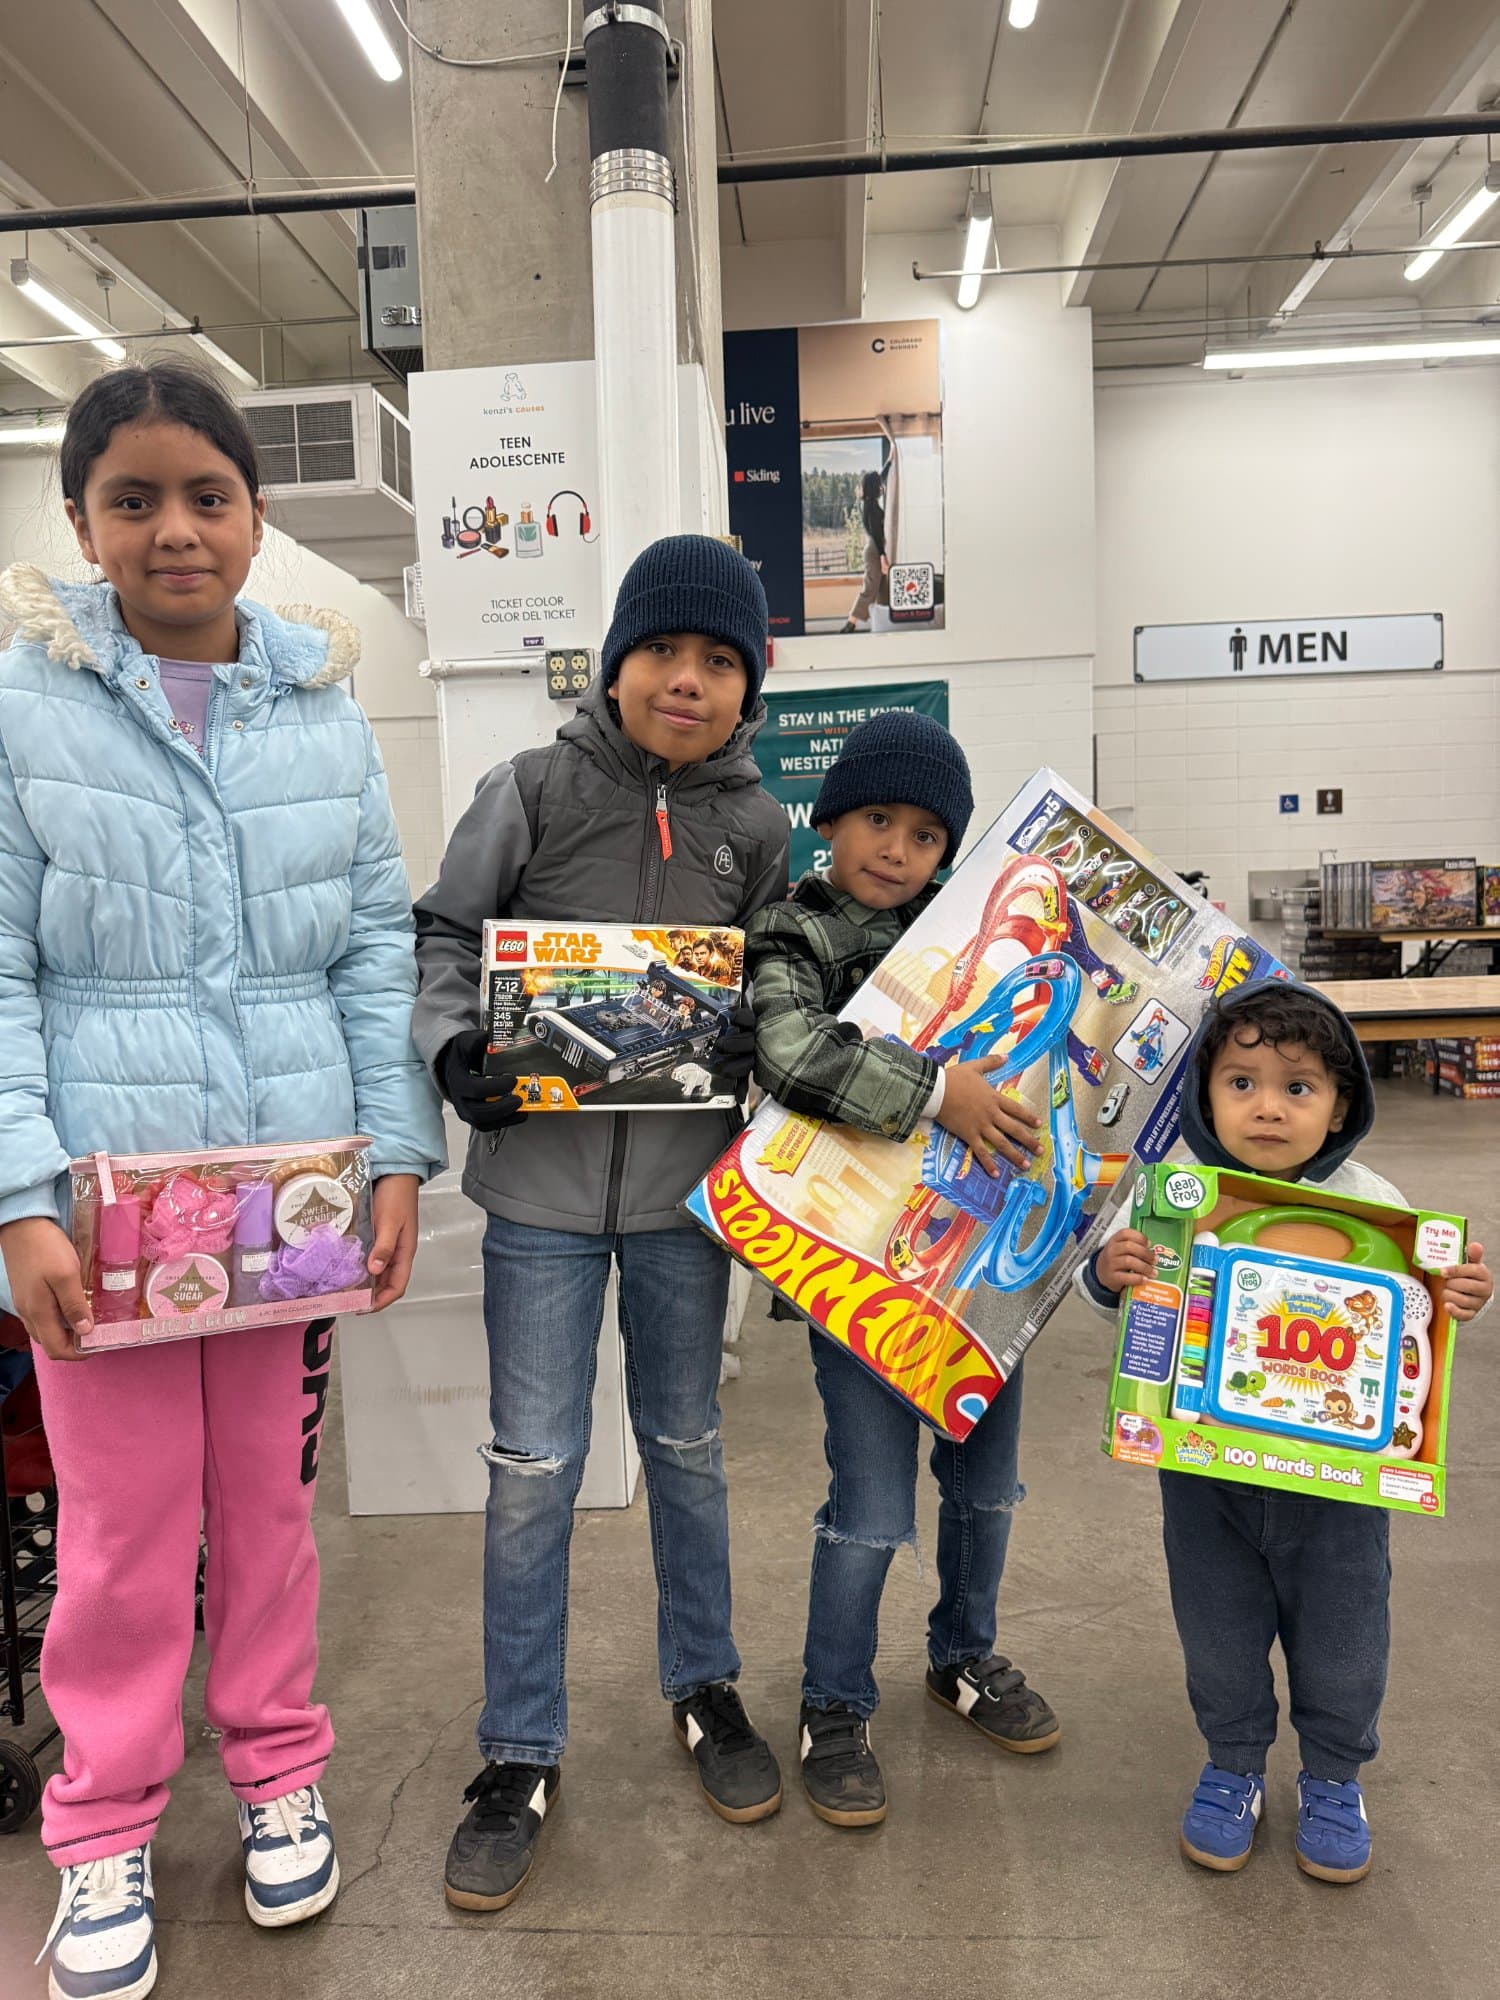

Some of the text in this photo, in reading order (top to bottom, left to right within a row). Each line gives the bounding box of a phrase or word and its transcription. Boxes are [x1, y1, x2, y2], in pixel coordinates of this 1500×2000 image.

[483, 407, 513, 415] kenzi's
[740, 401, 775, 424] live
[499, 436, 531, 449] TEEN
[469, 452, 565, 469] ADOLESCENTE
[746, 469, 780, 483] Siding
[490, 596, 564, 609] TICKET COLOR
[481, 608, 576, 623] COLOR DEL TICKET
[1258, 631, 1348, 665] MEN
[778, 712, 815, 727] STAY
[818, 710, 833, 725] IN
[837, 708, 866, 723] THE
[823, 727, 848, 735] WITH
[497, 939, 526, 953] LEGO
[533, 932, 602, 948] STAR
[533, 947, 602, 963] WARS
[494, 981, 519, 992] 7-12
[493, 1012, 511, 1020] 345
[1169, 1177, 1196, 1192] Leap
[1173, 1189, 1200, 1204] Frog
[301, 1205, 329, 1217] SWEET
[1425, 1226, 1440, 1237] Try
[1159, 1255, 1180, 1267] ngual
[1240, 1271, 1257, 1281] Leap
[1242, 1278, 1258, 1287] Frog
[178, 1283, 201, 1292] PINK
[173, 1291, 204, 1301] SUGAR
[1256, 1314, 1357, 1371] 100
[1261, 1361, 1346, 1387] WORDS BOOK
[1224, 1446, 1364, 1487] 100 Words Book
